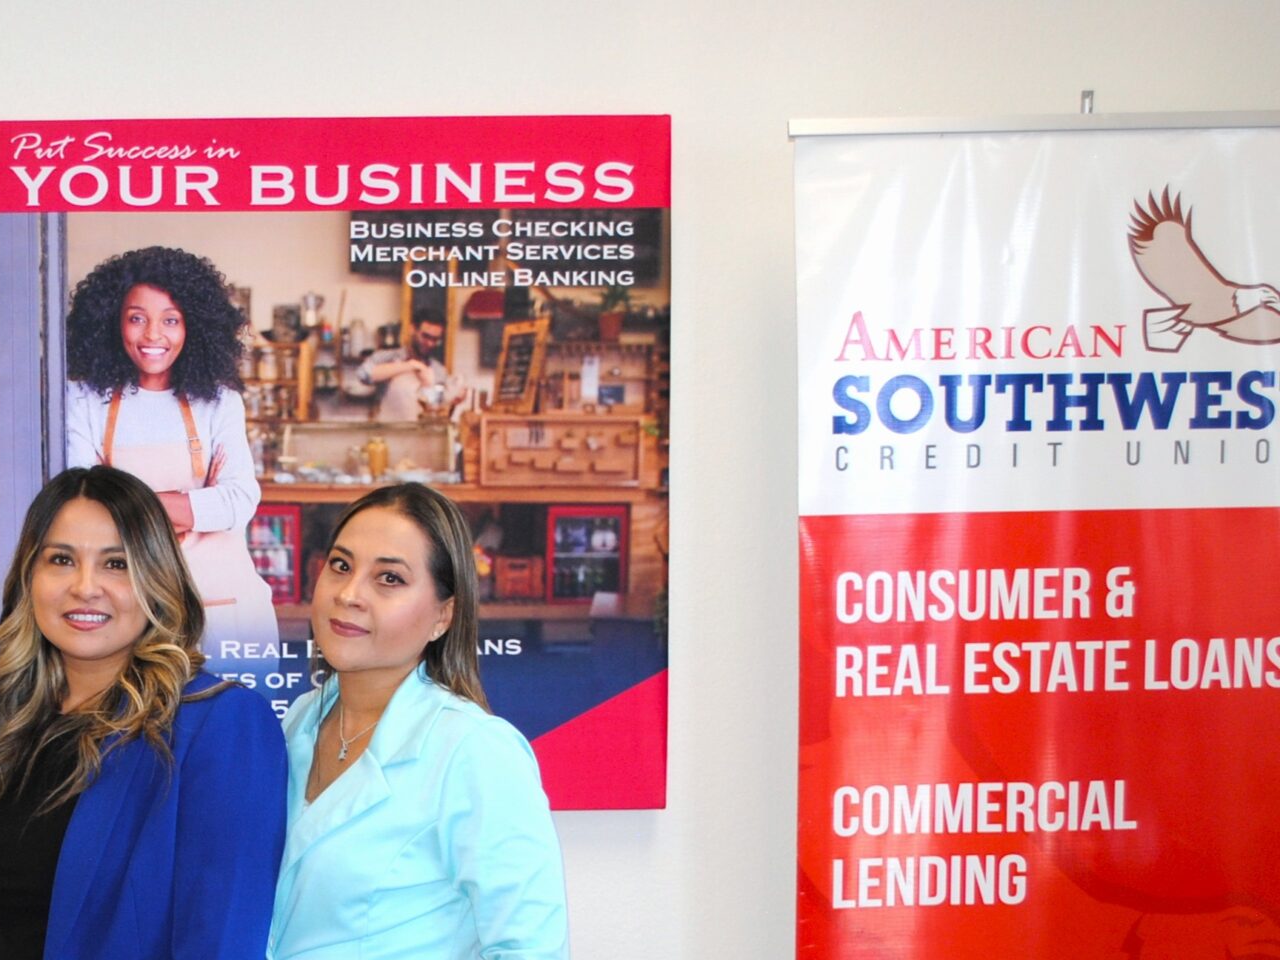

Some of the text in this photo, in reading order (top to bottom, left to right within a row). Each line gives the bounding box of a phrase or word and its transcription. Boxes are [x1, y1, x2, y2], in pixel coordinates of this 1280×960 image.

[10, 131, 240, 162] Put Success in
[10, 161, 635, 207] YOUR BUSINESS
[350, 219, 634, 239] BUSINESS CHECKING
[350, 242, 635, 263] MERCHANT SERVICES
[406, 269, 634, 288] ONLINE BANKING
[834, 310, 1127, 362] AMERICAN
[832, 370, 1280, 435] SOUTHWES
[835, 442, 1063, 471] CREDIT
[835, 566, 1136, 624] CONSUMER &
[220, 640, 298, 659] REAL
[835, 643, 950, 697] REAL
[963, 640, 1130, 694] ESTATE
[265, 672, 303, 689] OF
[832, 780, 1138, 837] COMMERCIAL
[832, 854, 1028, 909] LENDING
